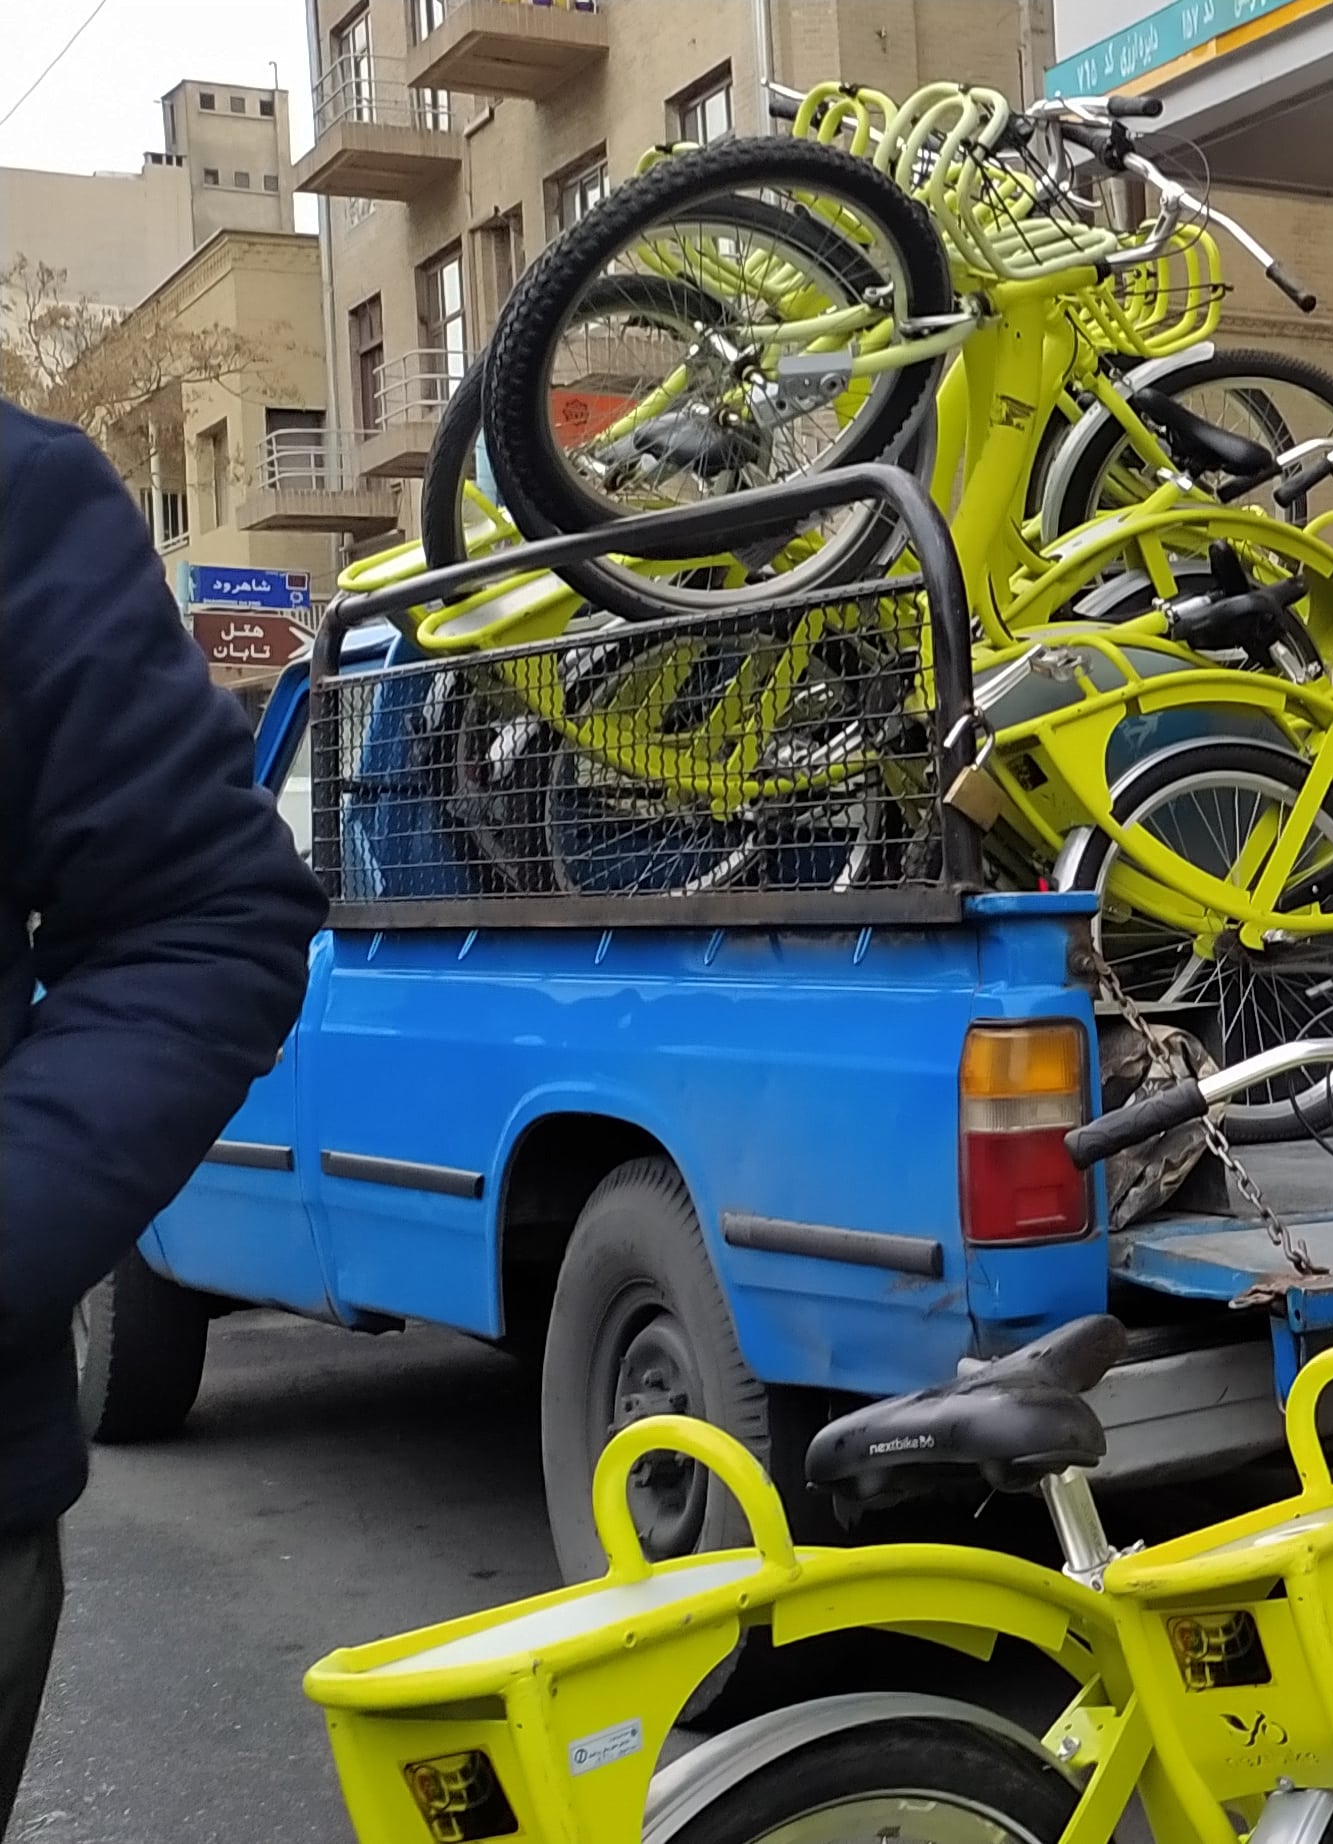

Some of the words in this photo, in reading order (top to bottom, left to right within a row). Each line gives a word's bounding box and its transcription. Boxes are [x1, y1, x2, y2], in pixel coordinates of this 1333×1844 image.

[213, 579, 271, 594] شاهرود
[220, 621, 264, 640] هتل
[213, 643, 271, 661] تابان
[869, 1436, 919, 1456] nextbike
